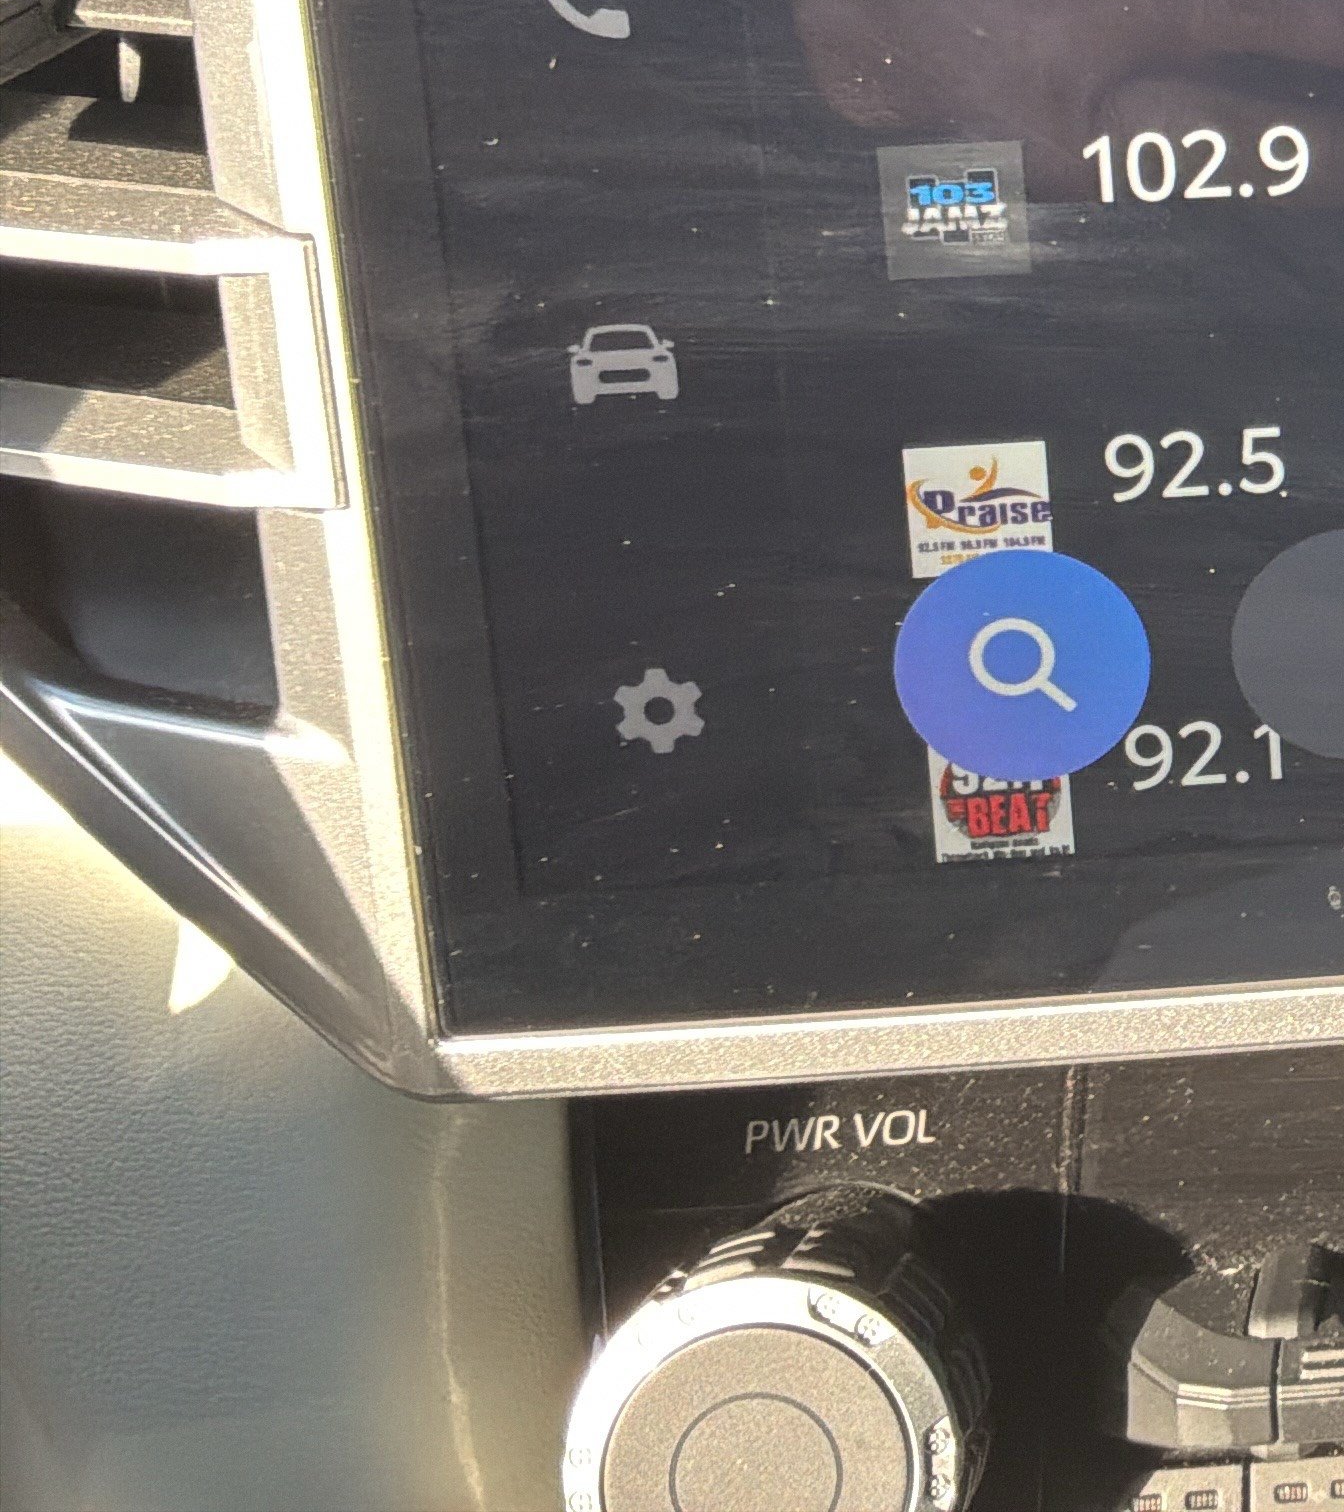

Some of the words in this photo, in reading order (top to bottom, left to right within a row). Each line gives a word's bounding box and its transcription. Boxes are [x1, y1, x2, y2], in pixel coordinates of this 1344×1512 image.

[1082, 124, 1310, 203] 102.9
[911, 183, 996, 206] 103
[1104, 425, 1285, 503] 92.5
[1125, 721, 1282, 791] 92.1
[967, 792, 1050, 837] BEAT
[744, 1113, 843, 1155] PWR
[852, 1108, 937, 1148] VOL
